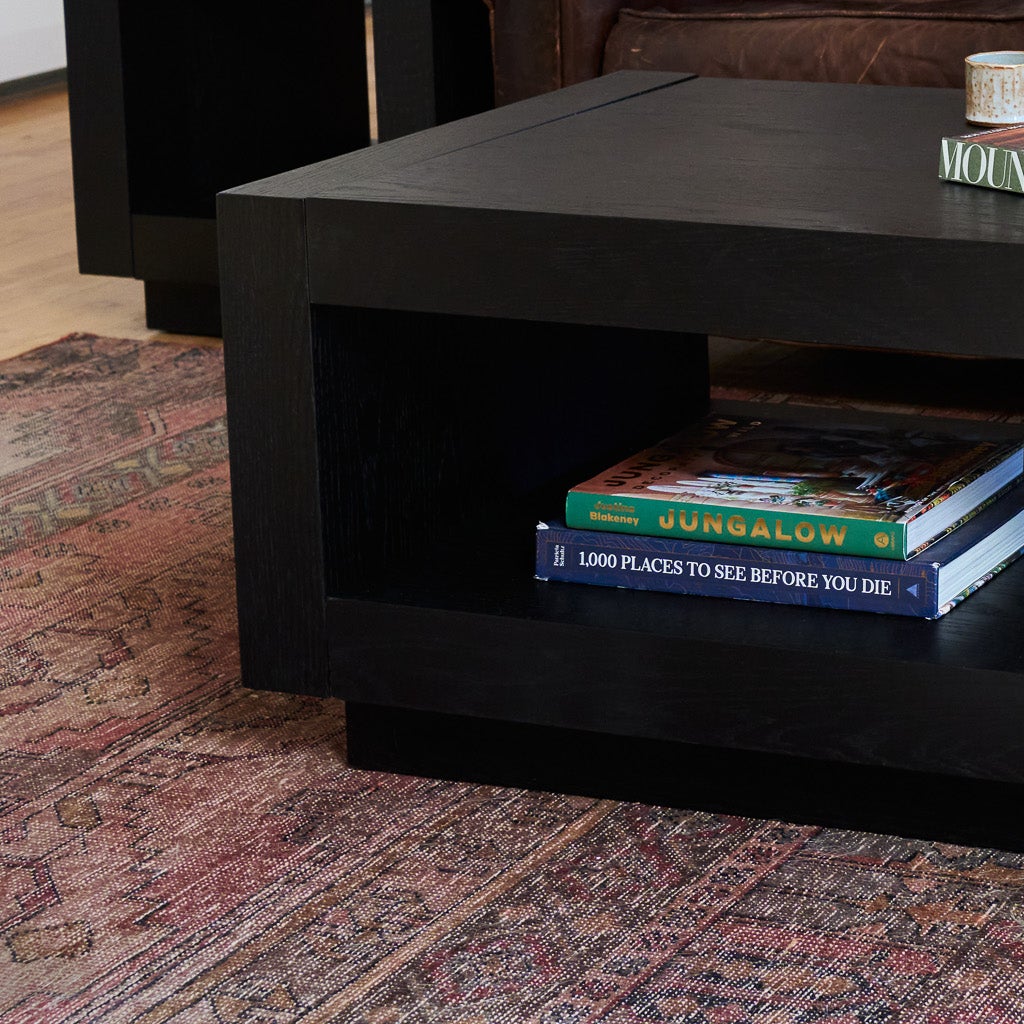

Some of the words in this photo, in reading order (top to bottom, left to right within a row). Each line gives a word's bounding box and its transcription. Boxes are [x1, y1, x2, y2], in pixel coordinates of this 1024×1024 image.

[589, 511, 640, 526] Blakeney
[594, 502, 635, 513] Justine
[658, 508, 848, 547] JUNGALOW
[578, 551, 617, 569] 1,000
[620, 554, 683, 576] PLACES
[686, 561, 711, 578] TO
[714, 564, 747, 582] SEE
[750, 567, 819, 589] BEFORE
[822, 574, 858, 592] YOU
[861, 578, 892, 596] DIE
